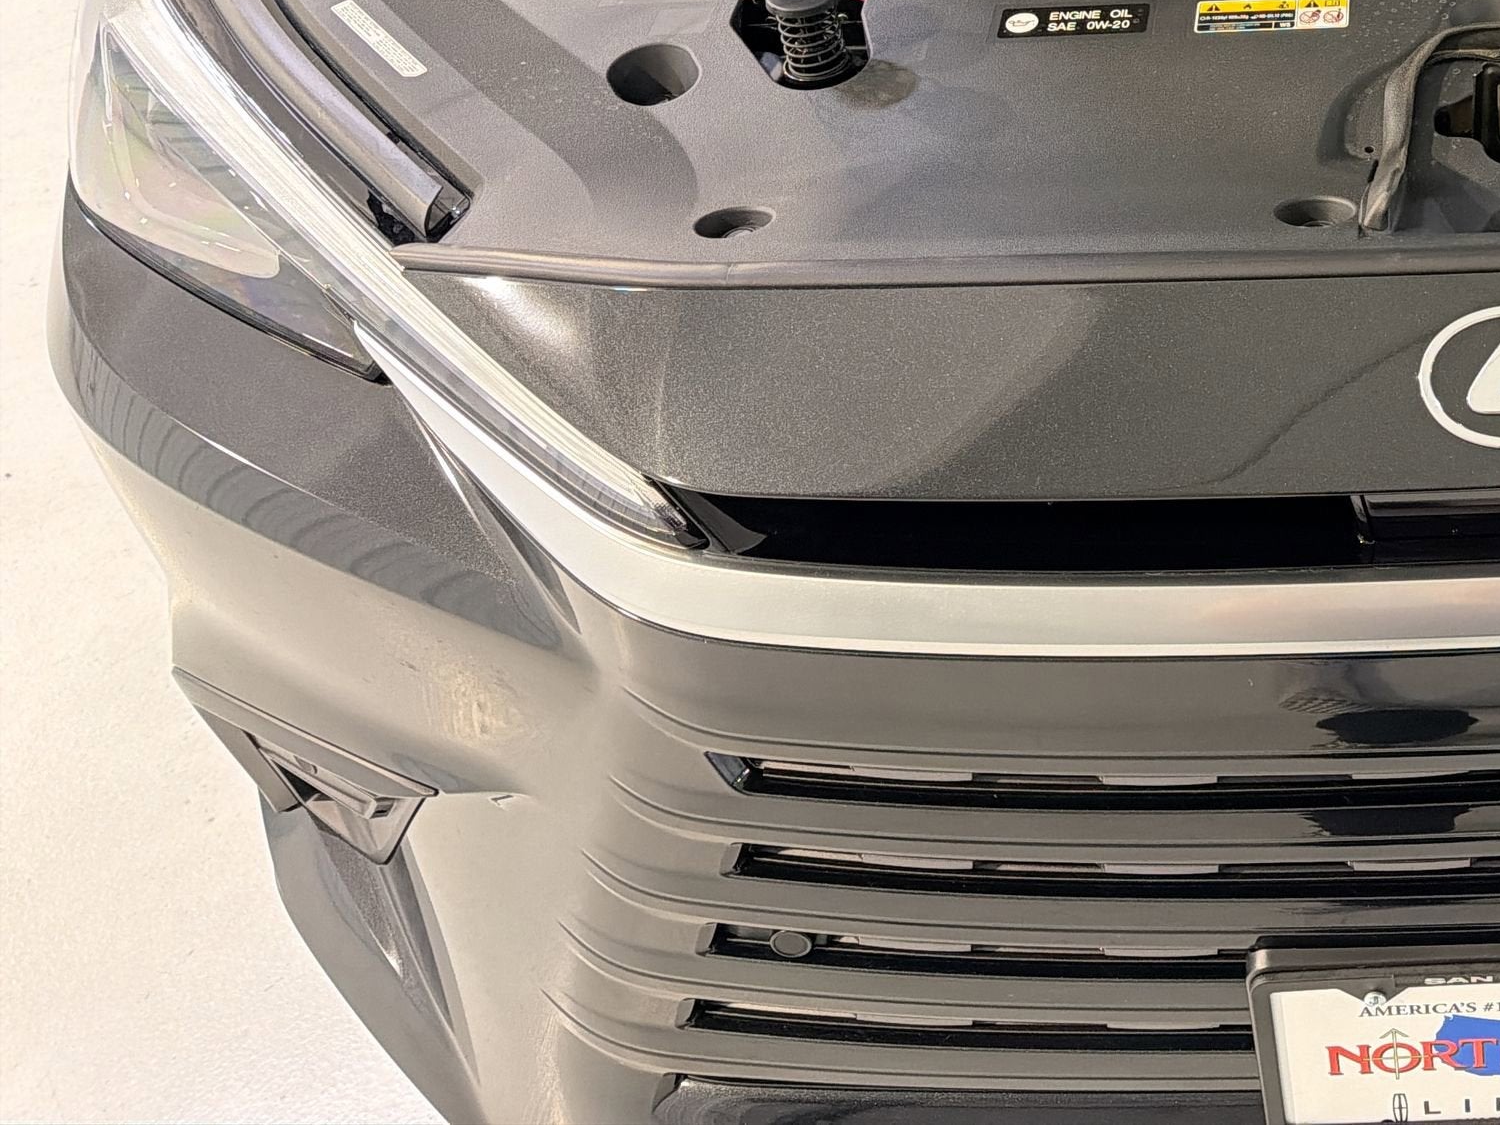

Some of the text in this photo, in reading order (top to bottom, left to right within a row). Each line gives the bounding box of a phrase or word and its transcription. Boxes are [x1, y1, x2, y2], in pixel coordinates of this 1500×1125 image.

[1049, 9, 1133, 21] ENGINE OIL
[1047, 19, 1131, 32] SAE 0W-20
[1424, 976, 1493, 985] SAN
[1358, 1001, 1477, 1017] AMERICA'S
